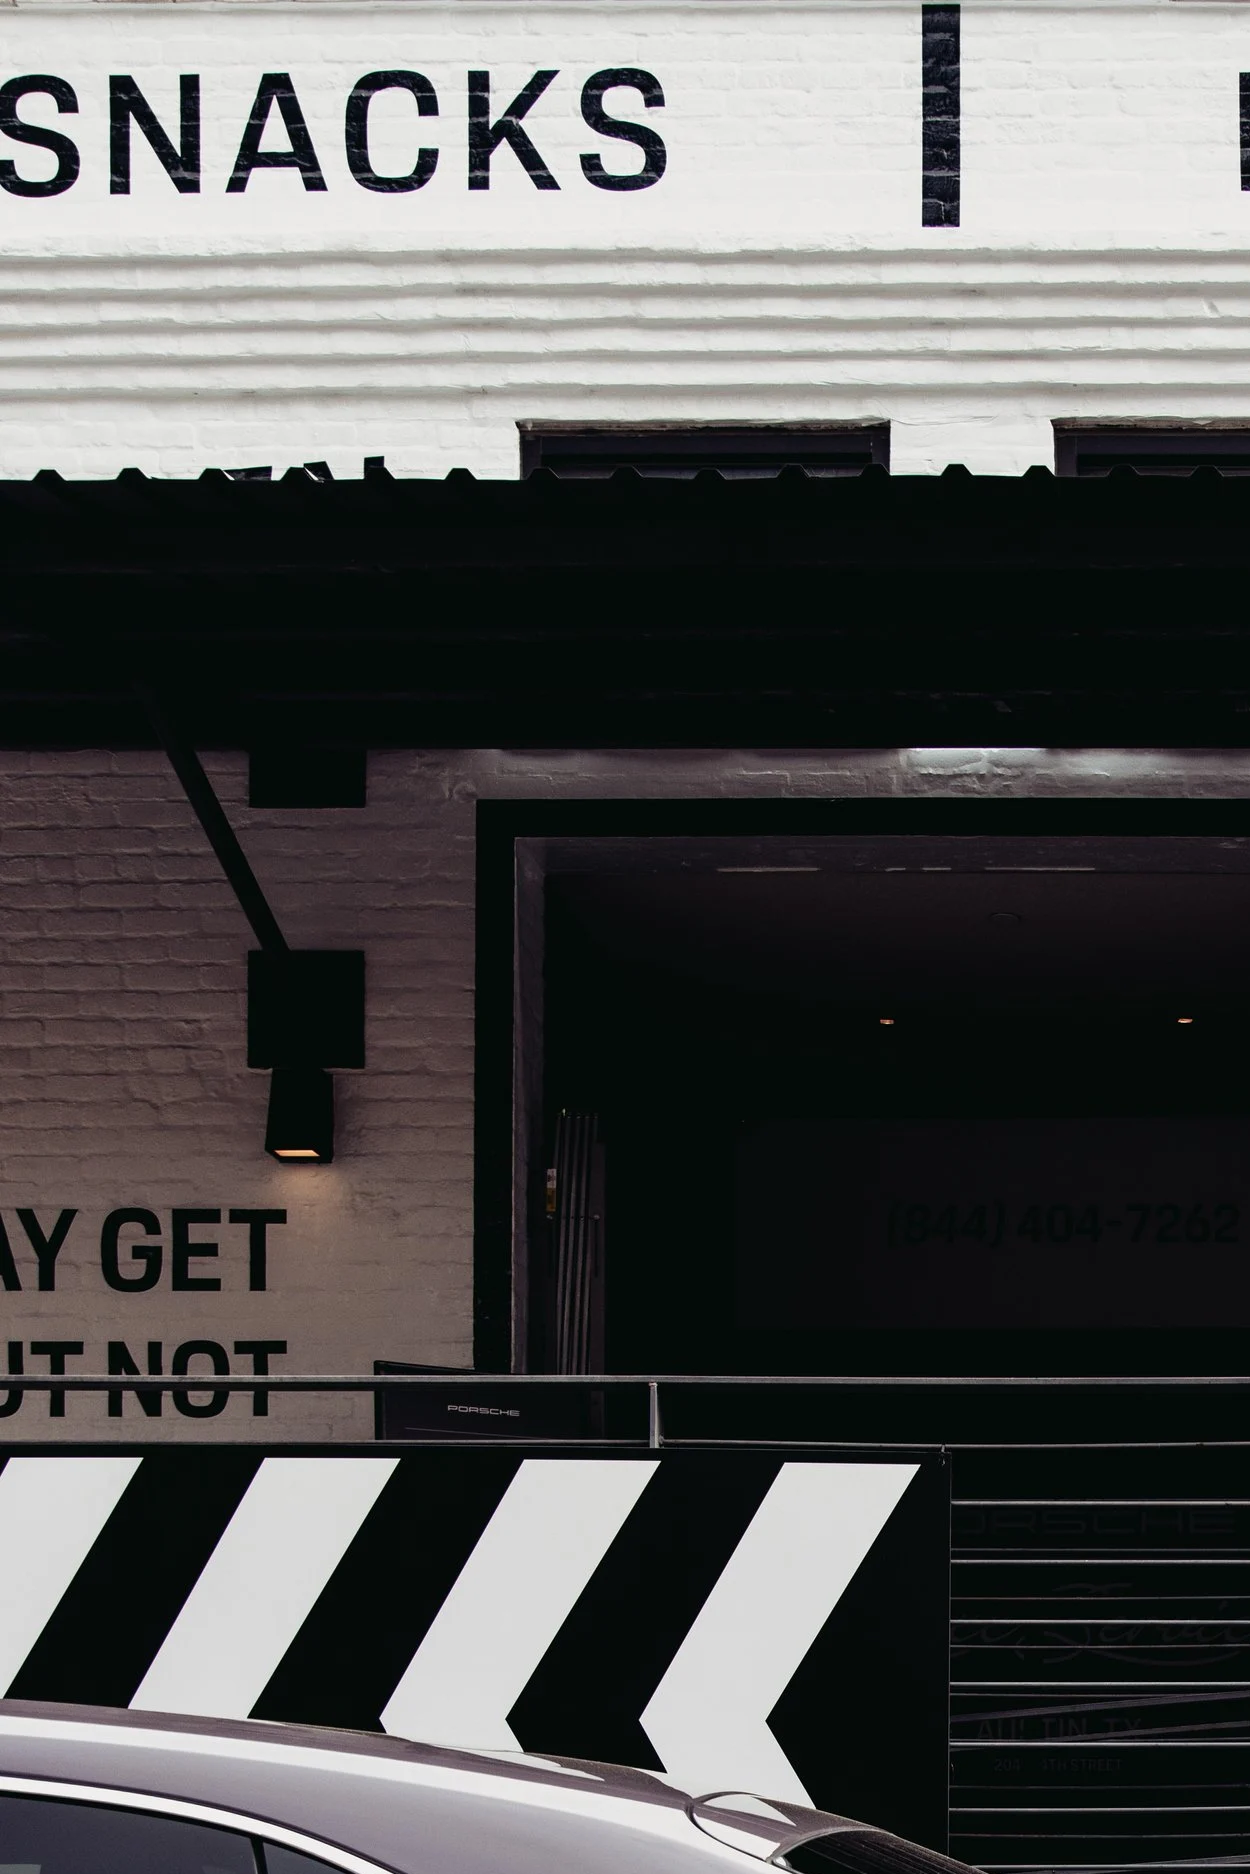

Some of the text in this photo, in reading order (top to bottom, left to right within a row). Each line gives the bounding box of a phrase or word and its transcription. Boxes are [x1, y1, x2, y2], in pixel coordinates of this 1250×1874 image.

[0, 68, 667, 197] SNACKS
[101, 1207, 287, 1292] GET
[887, 1202, 1241, 1248] (844) 404-7262
[108, 1340, 287, 1418] NOT
[447, 1404, 520, 1417] PORSCHE
[949, 1508, 1237, 1535] ORSCHE
